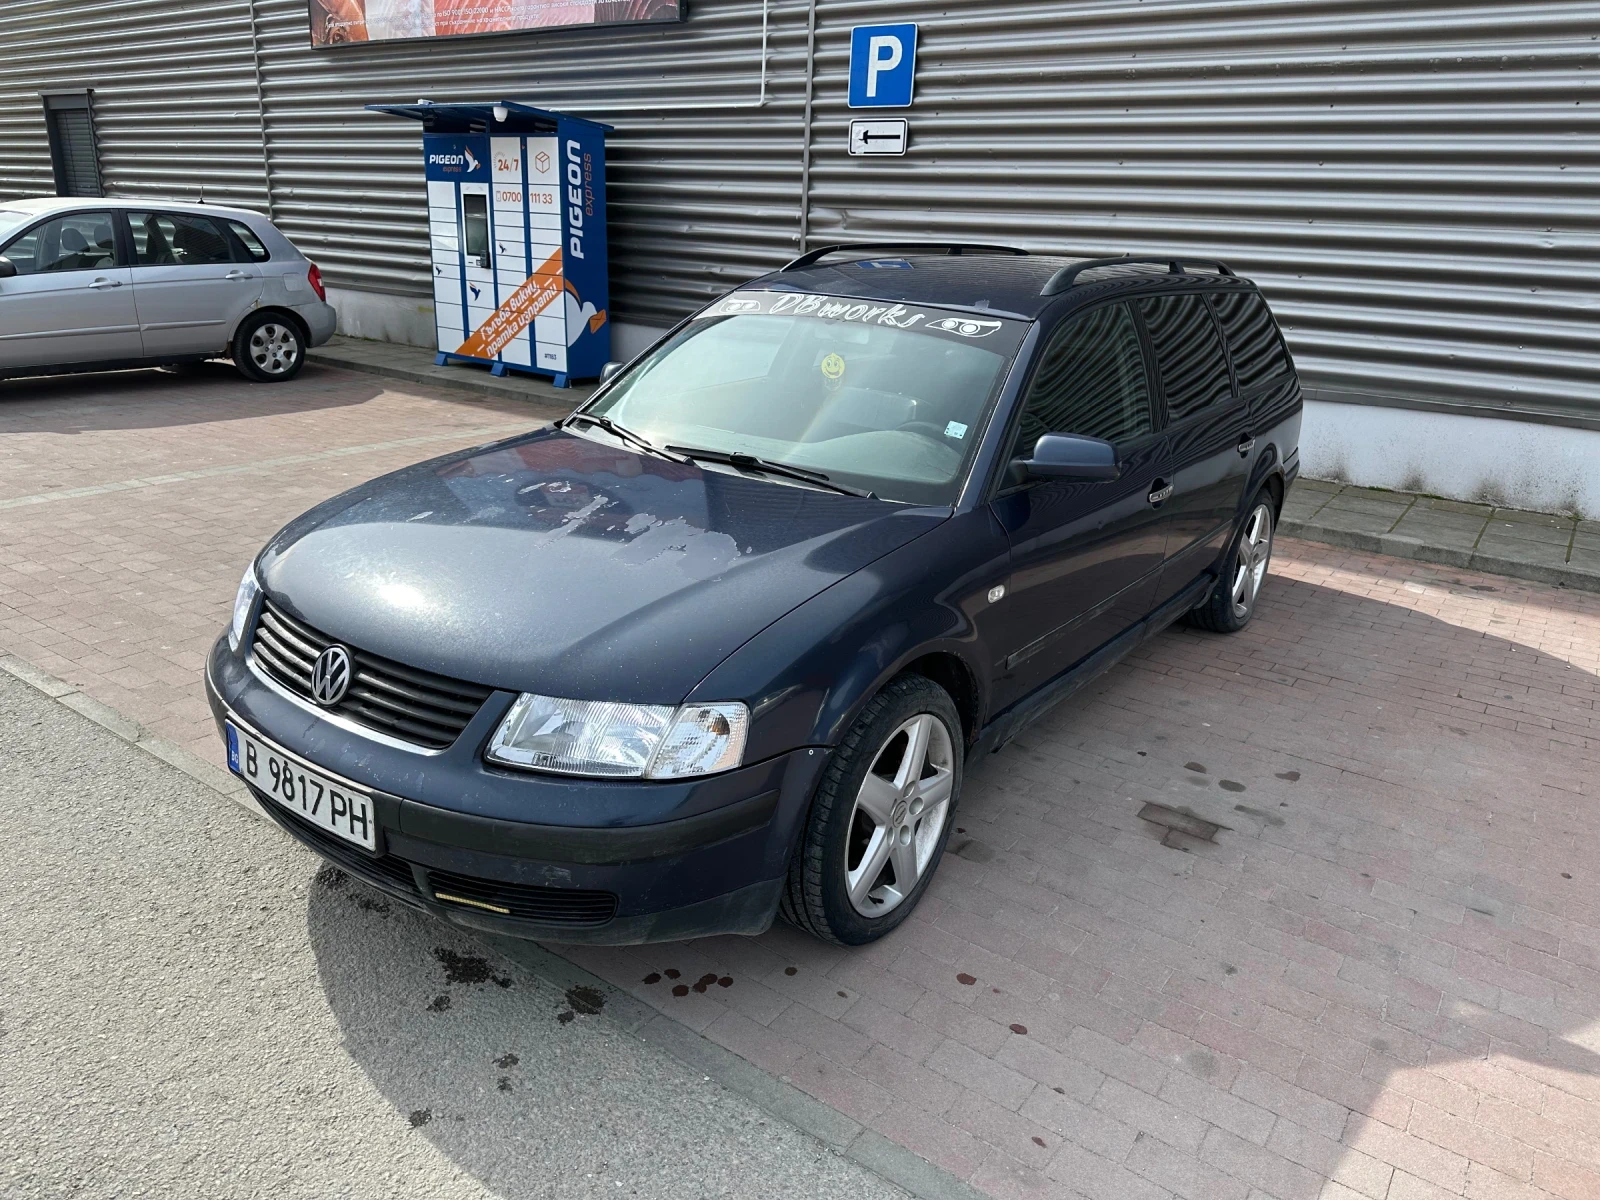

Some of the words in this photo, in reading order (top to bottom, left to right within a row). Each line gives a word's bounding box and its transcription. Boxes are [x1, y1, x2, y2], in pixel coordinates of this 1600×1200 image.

[866, 35, 903, 97] P
[429, 154, 464, 165] PIGEON
[497, 157, 519, 173] 24/7
[502, 191, 522, 203] 0700
[530, 193, 541, 203] 111
[542, 193, 553, 204] 33
[566, 139, 585, 259] PIGEON
[583, 152, 596, 216] express
[480, 306, 511, 340] Гълъба
[486, 322, 519, 357] пратка
[518, 283, 558, 327] изпрати
[231, 750, 239, 764] BG
[245, 739, 258, 778] B
[268, 756, 324, 816] 9817
[329, 789, 368, 841] PH
